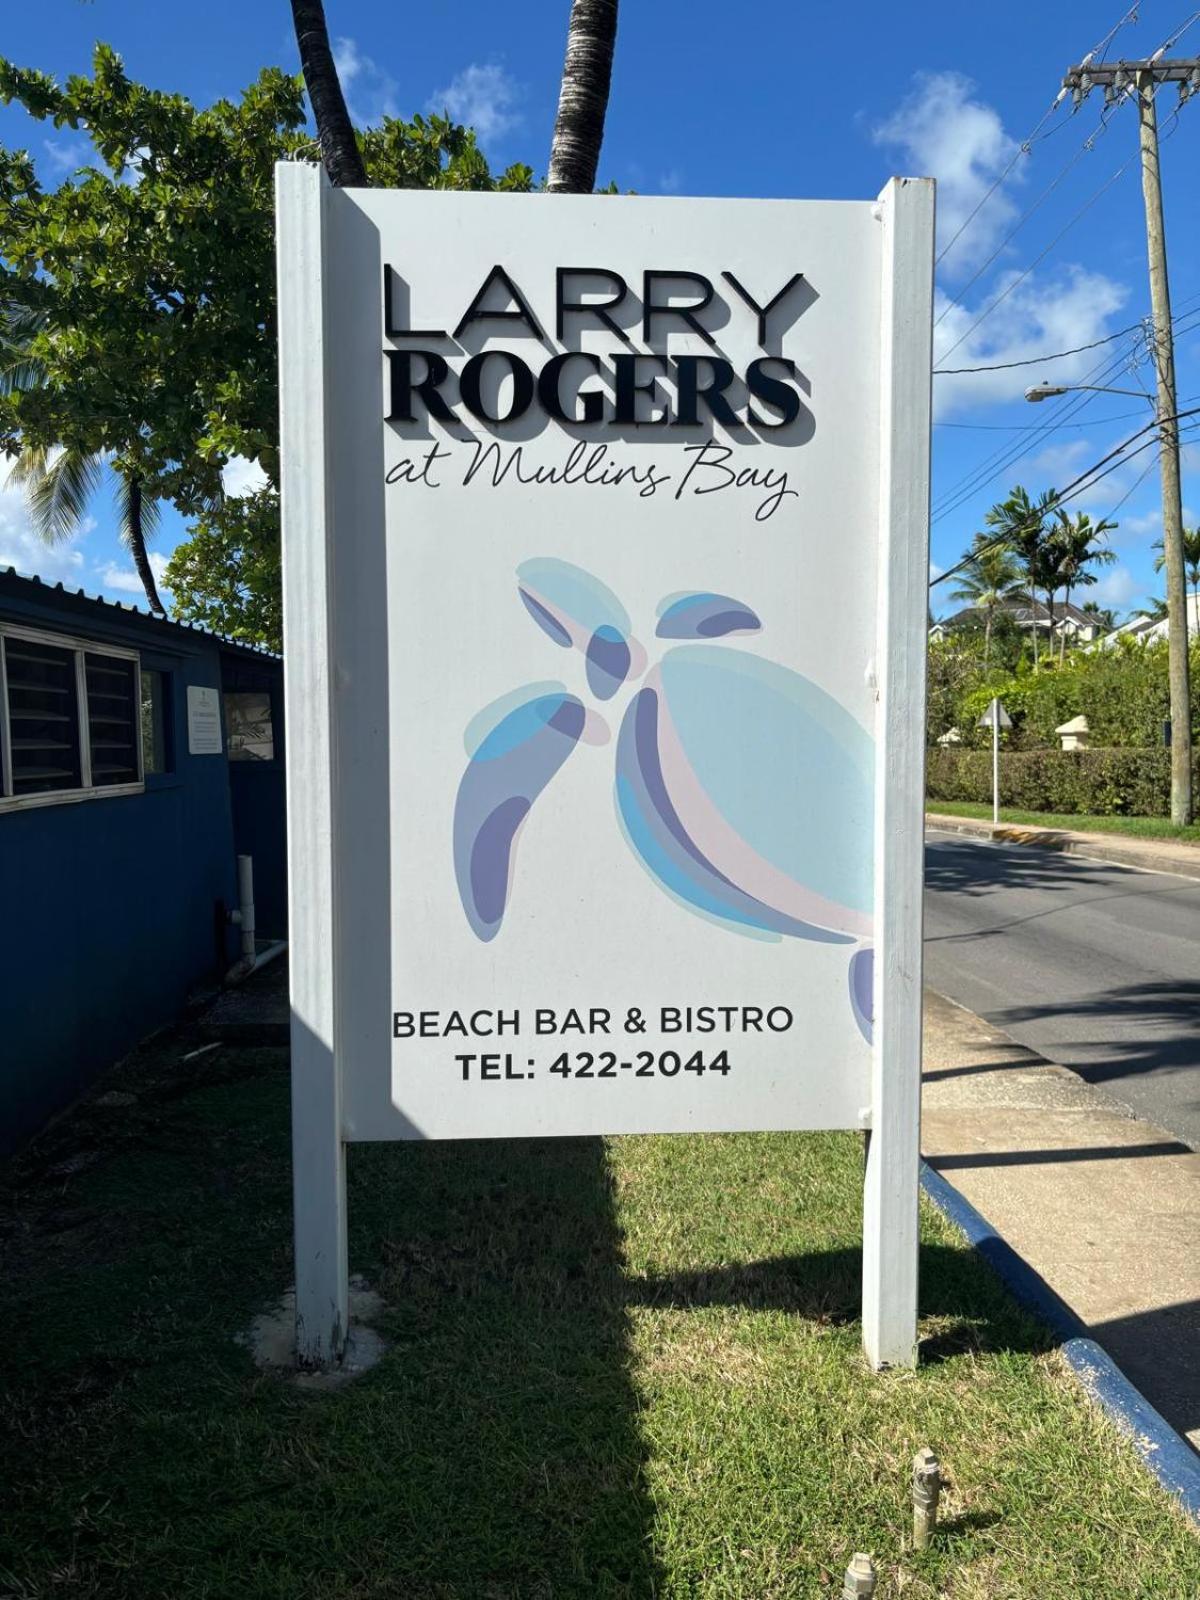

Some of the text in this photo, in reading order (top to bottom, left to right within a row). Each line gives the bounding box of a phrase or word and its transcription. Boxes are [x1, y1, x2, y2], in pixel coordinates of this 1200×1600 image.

[383, 262, 805, 347] LARRY
[382, 349, 801, 429] ROGERS
[384, 438, 799, 521] at Mullins Bay
[392, 1005, 795, 1038] BEACH BAR & BISTRO
[454, 1050, 732, 1081] TEL: 422-2044
